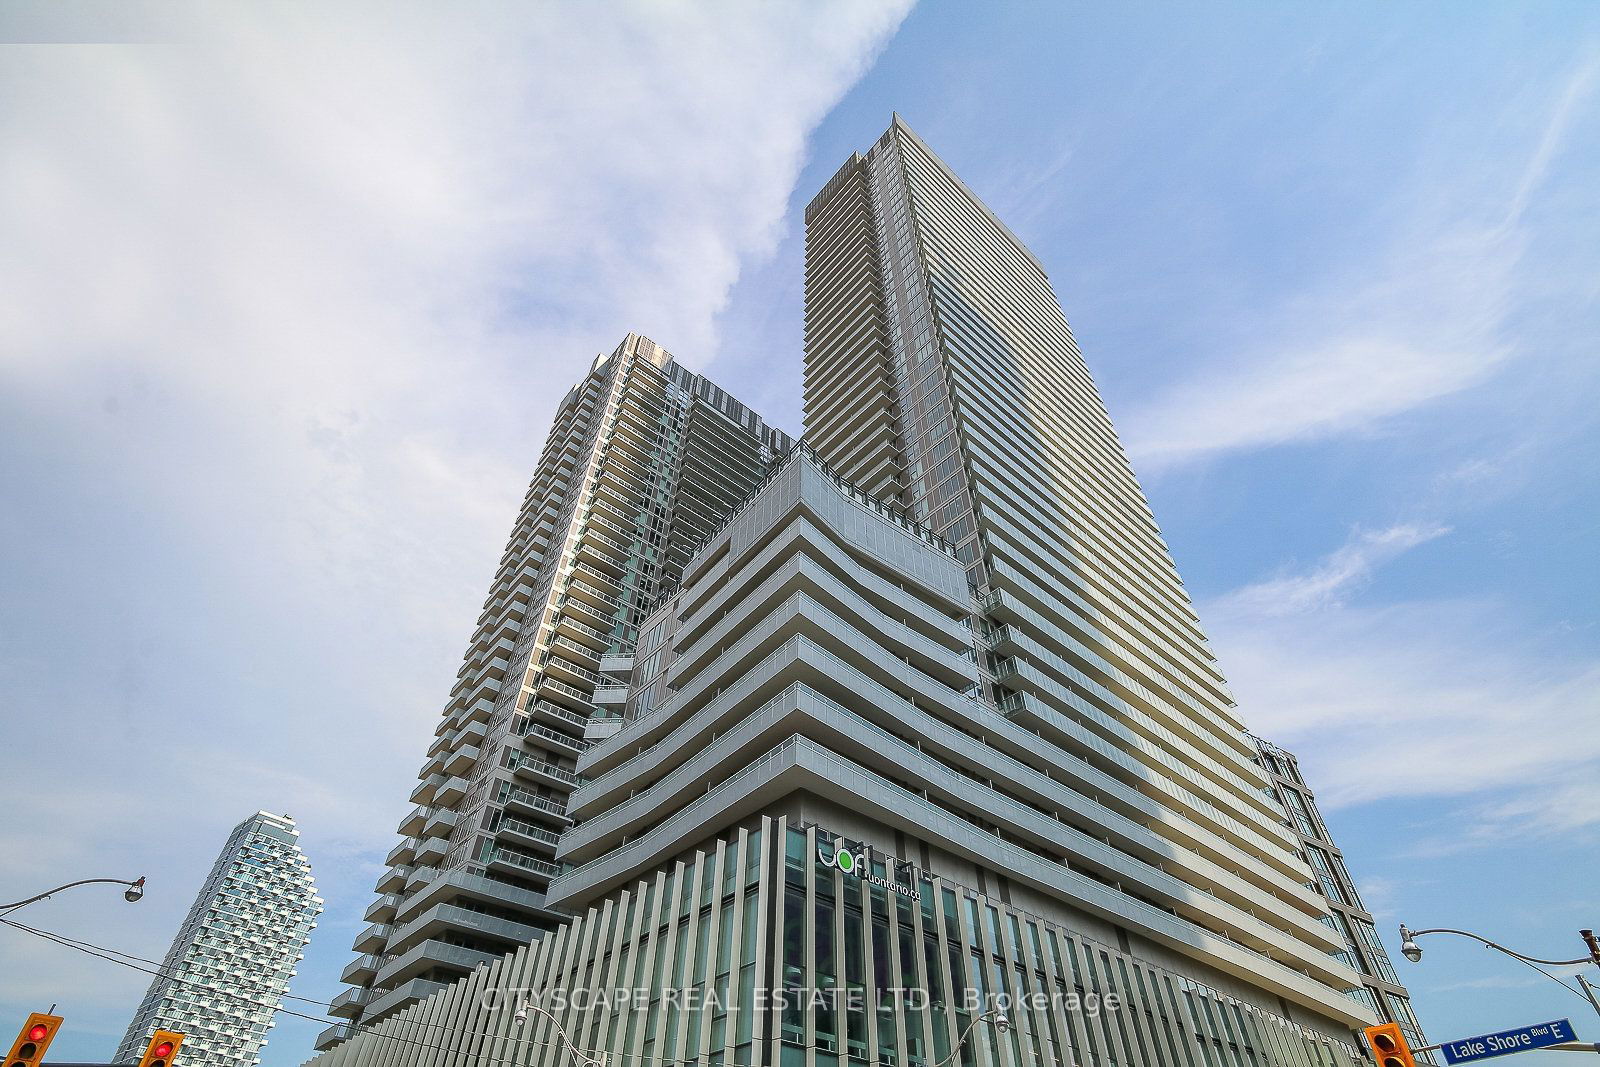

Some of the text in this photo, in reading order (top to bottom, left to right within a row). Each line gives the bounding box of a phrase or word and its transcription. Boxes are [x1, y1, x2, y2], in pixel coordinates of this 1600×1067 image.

[868, 874, 921, 902] uontario.ca
[1450, 1022, 1564, 1059] Lake Shore Blvd E
